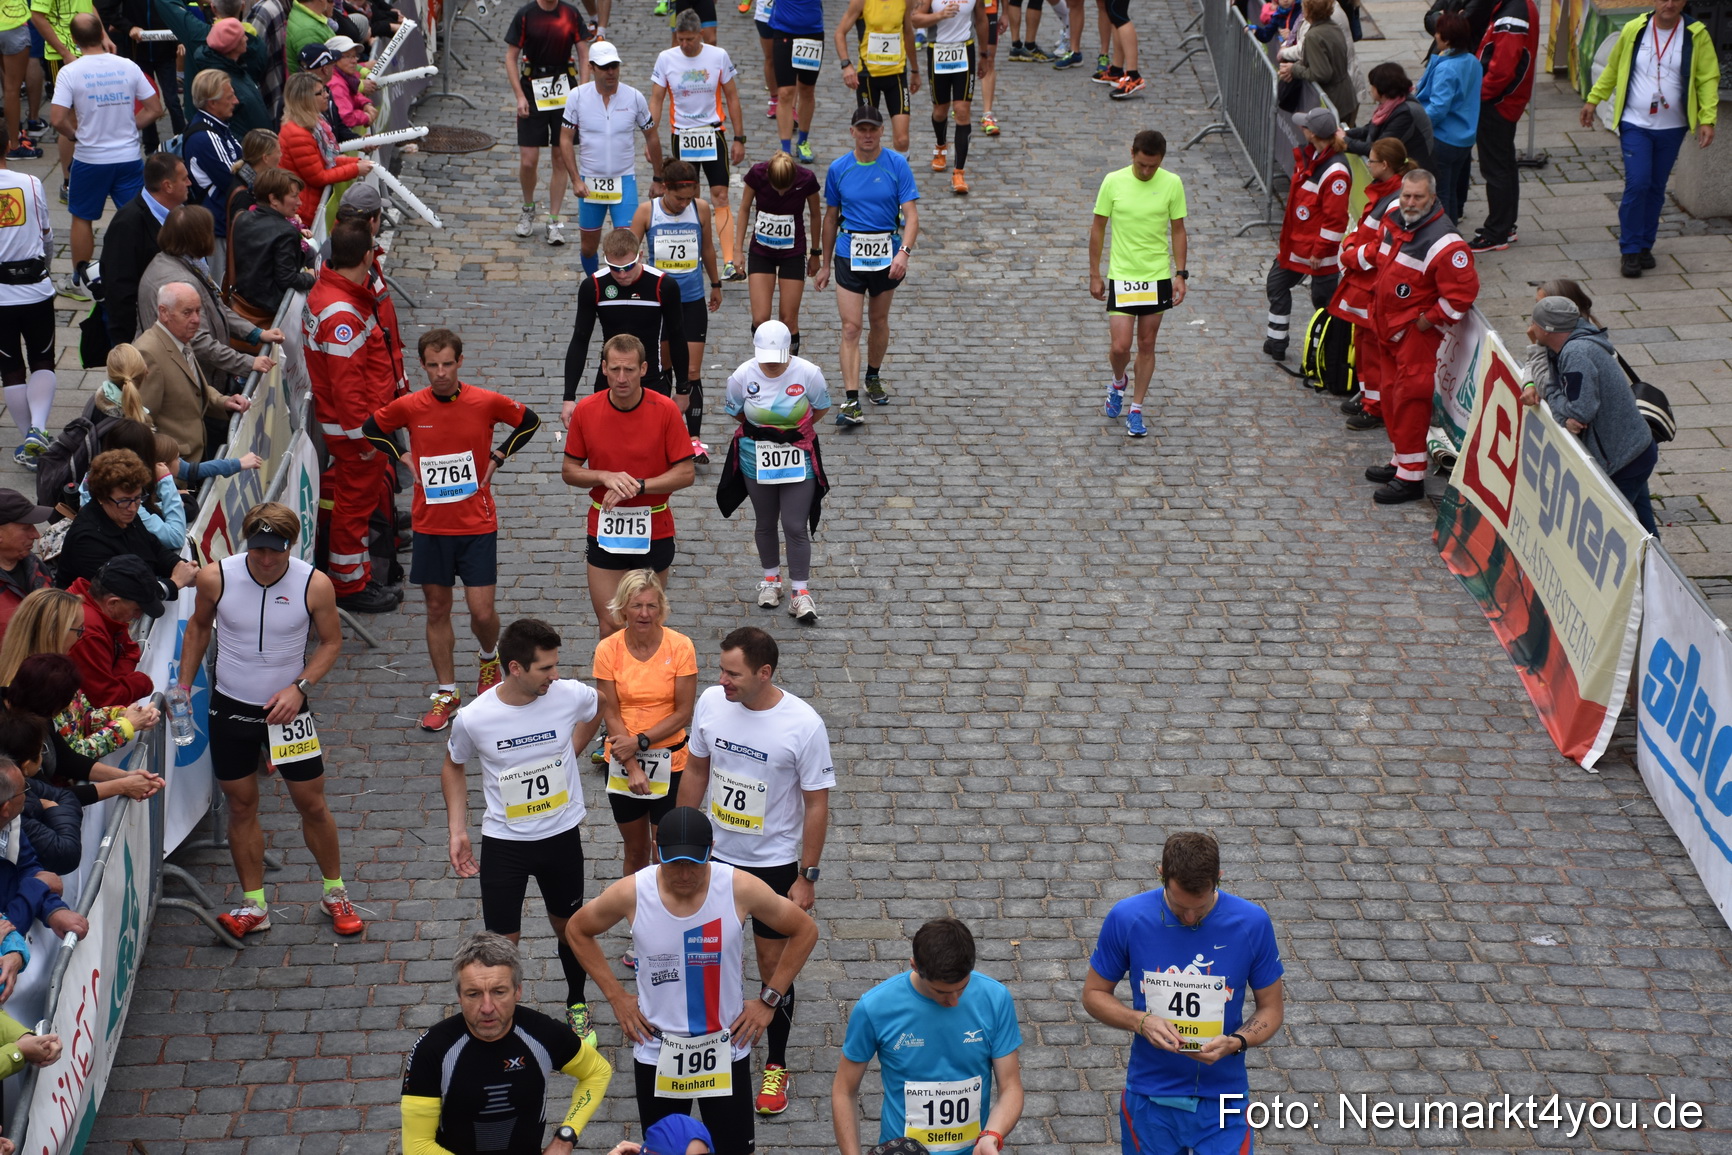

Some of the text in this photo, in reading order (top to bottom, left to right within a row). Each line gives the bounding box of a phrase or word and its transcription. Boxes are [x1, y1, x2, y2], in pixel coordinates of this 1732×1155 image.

[795, 45, 820, 59] 2771
[882, 41, 890, 53] 2
[937, 49, 964, 62] 2207
[95, 92, 125, 103] HASIT
[541, 83, 564, 98] 342
[683, 135, 713, 149] 3004
[593, 178, 615, 191] 128
[759, 221, 792, 238] 2240
[766, 238, 782, 246] Sarah
[668, 244, 686, 260] 73
[855, 242, 889, 257] 2024
[662, 261, 691, 269] Eva-Maria
[438, 457, 465, 465] Neumarkt
[761, 449, 801, 468] 3070
[426, 463, 472, 486] 2764
[439, 487, 464, 497] Jürgen
[603, 517, 647, 535] 3015
[282, 716, 313, 742] 530
[279, 742, 317, 758] URBEL
[500, 763, 554, 782] PARTL Neumarkt
[521, 774, 550, 800] 79
[727, 778, 756, 791] Neumarkt
[723, 785, 746, 812] 78
[527, 800, 552, 814] Frank
[717, 807, 751, 828] Wolfgang
[1146, 977, 1211, 989] PARTL Neumarkt
[1168, 991, 1201, 1018] 46
[663, 1038, 718, 1050] PARTL Neumarkt
[673, 1047, 717, 1076] 196
[671, 1077, 715, 1091] Reinhard
[935, 1087, 972, 1096] Neumarkt
[922, 1097, 970, 1126] 190
[927, 1131, 963, 1143] Steffen
